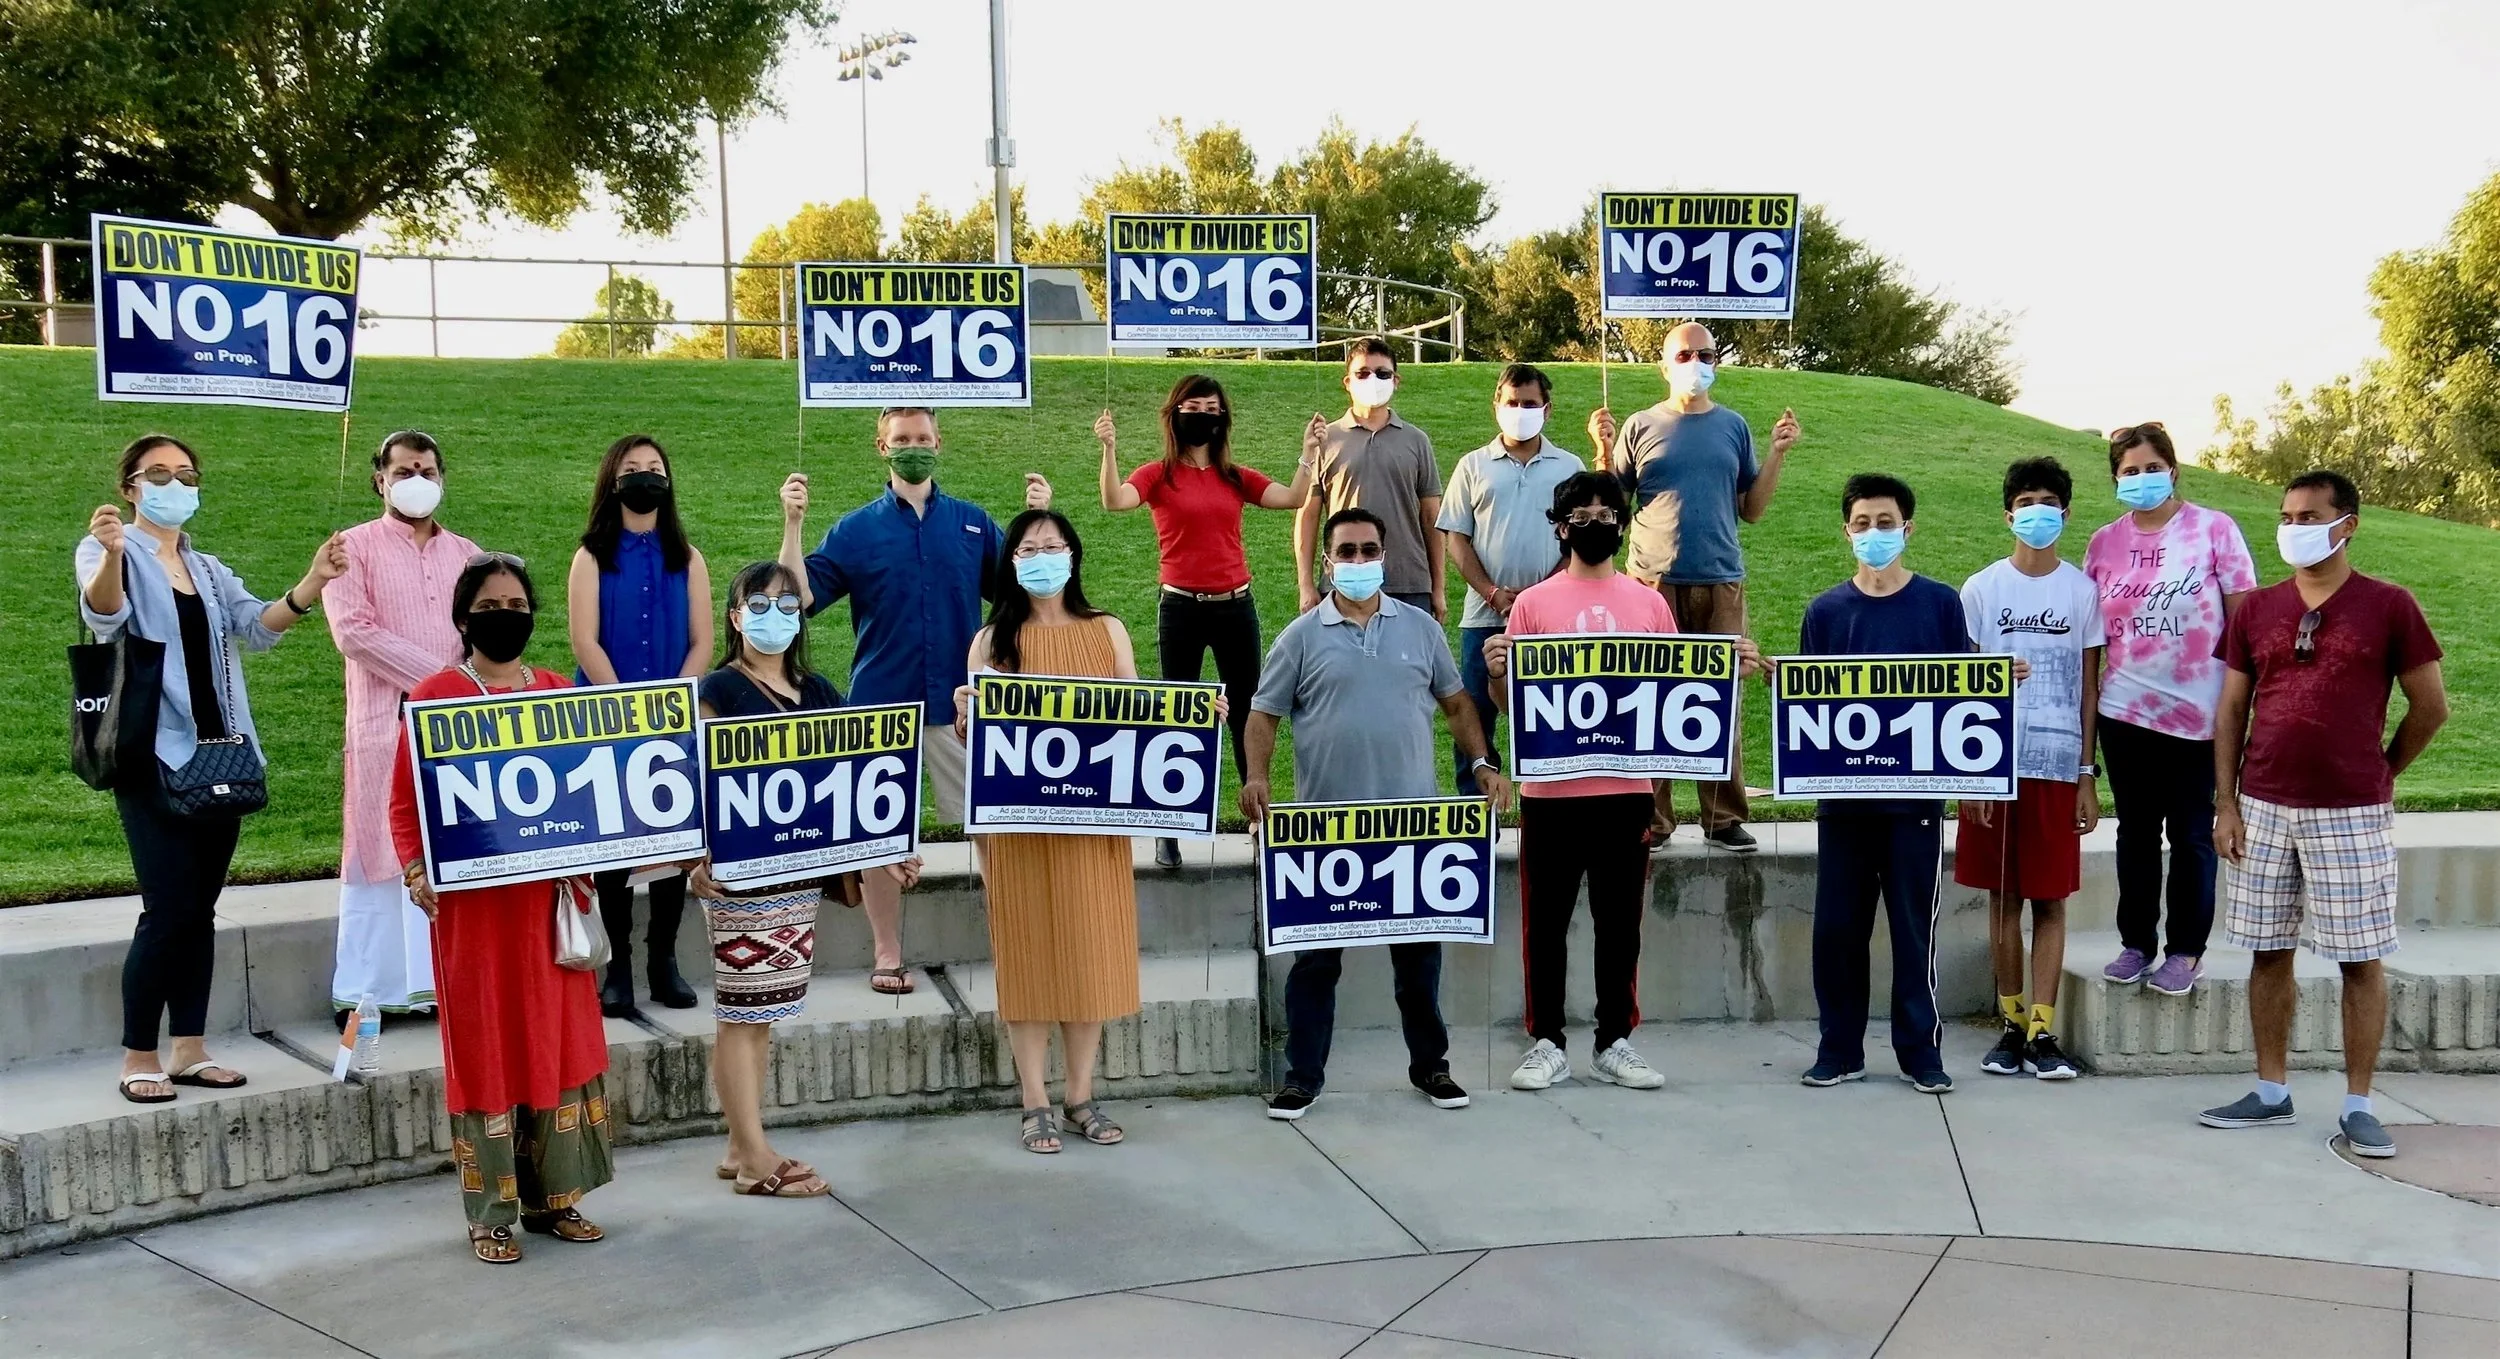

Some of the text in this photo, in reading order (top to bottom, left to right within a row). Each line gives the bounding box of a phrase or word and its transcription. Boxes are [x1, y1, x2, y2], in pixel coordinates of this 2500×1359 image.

[1610, 198, 1789, 226] DON'T DIVIDE US
[1118, 221, 1303, 250] DON'T DIVIDE US
[114, 230, 351, 290] DON'T DIVIDE US
[1611, 232, 1784, 293] NO 16
[811, 271, 1014, 302] DON'T DIVIDE US
[1120, 257, 1303, 321] NO 16
[1671, 278, 1699, 288] Prop.
[1187, 306, 1217, 318] Prop.
[116, 279, 348, 379] NO 16
[813, 309, 1015, 378] NO 16
[194, 350, 258, 366] on Prop.
[870, 362, 921, 373] on Prop.
[2130, 548, 2166, 568] THE
[2110, 616, 2184, 637] IS REAL
[1522, 643, 1725, 676] DON'T DIVIDE US
[1787, 662, 2003, 696] DON'T DIVIDE US
[985, 682, 1210, 724] DON'T DIVIDE US
[1524, 681, 1721, 752] NO 16
[428, 691, 684, 752] DON'T DIVIDE US
[716, 711, 910, 765] DON'T DIVIDE US
[1788, 701, 2003, 772] NO 16
[1577, 733, 1624, 745] on Prop.
[984, 726, 1205, 806] NO 16
[1846, 755, 1899, 767] on Prop.
[436, 740, 694, 835] NO 16
[719, 756, 906, 841] NO 16
[1041, 784, 1097, 797] on Prop.
[519, 820, 584, 837] on Prop.
[775, 827, 823, 842] on Prop.
[1273, 804, 1481, 843] DON'T DIVIDE US
[1275, 842, 1479, 915] NO 16
[1330, 901, 1381, 913] on Prop.
